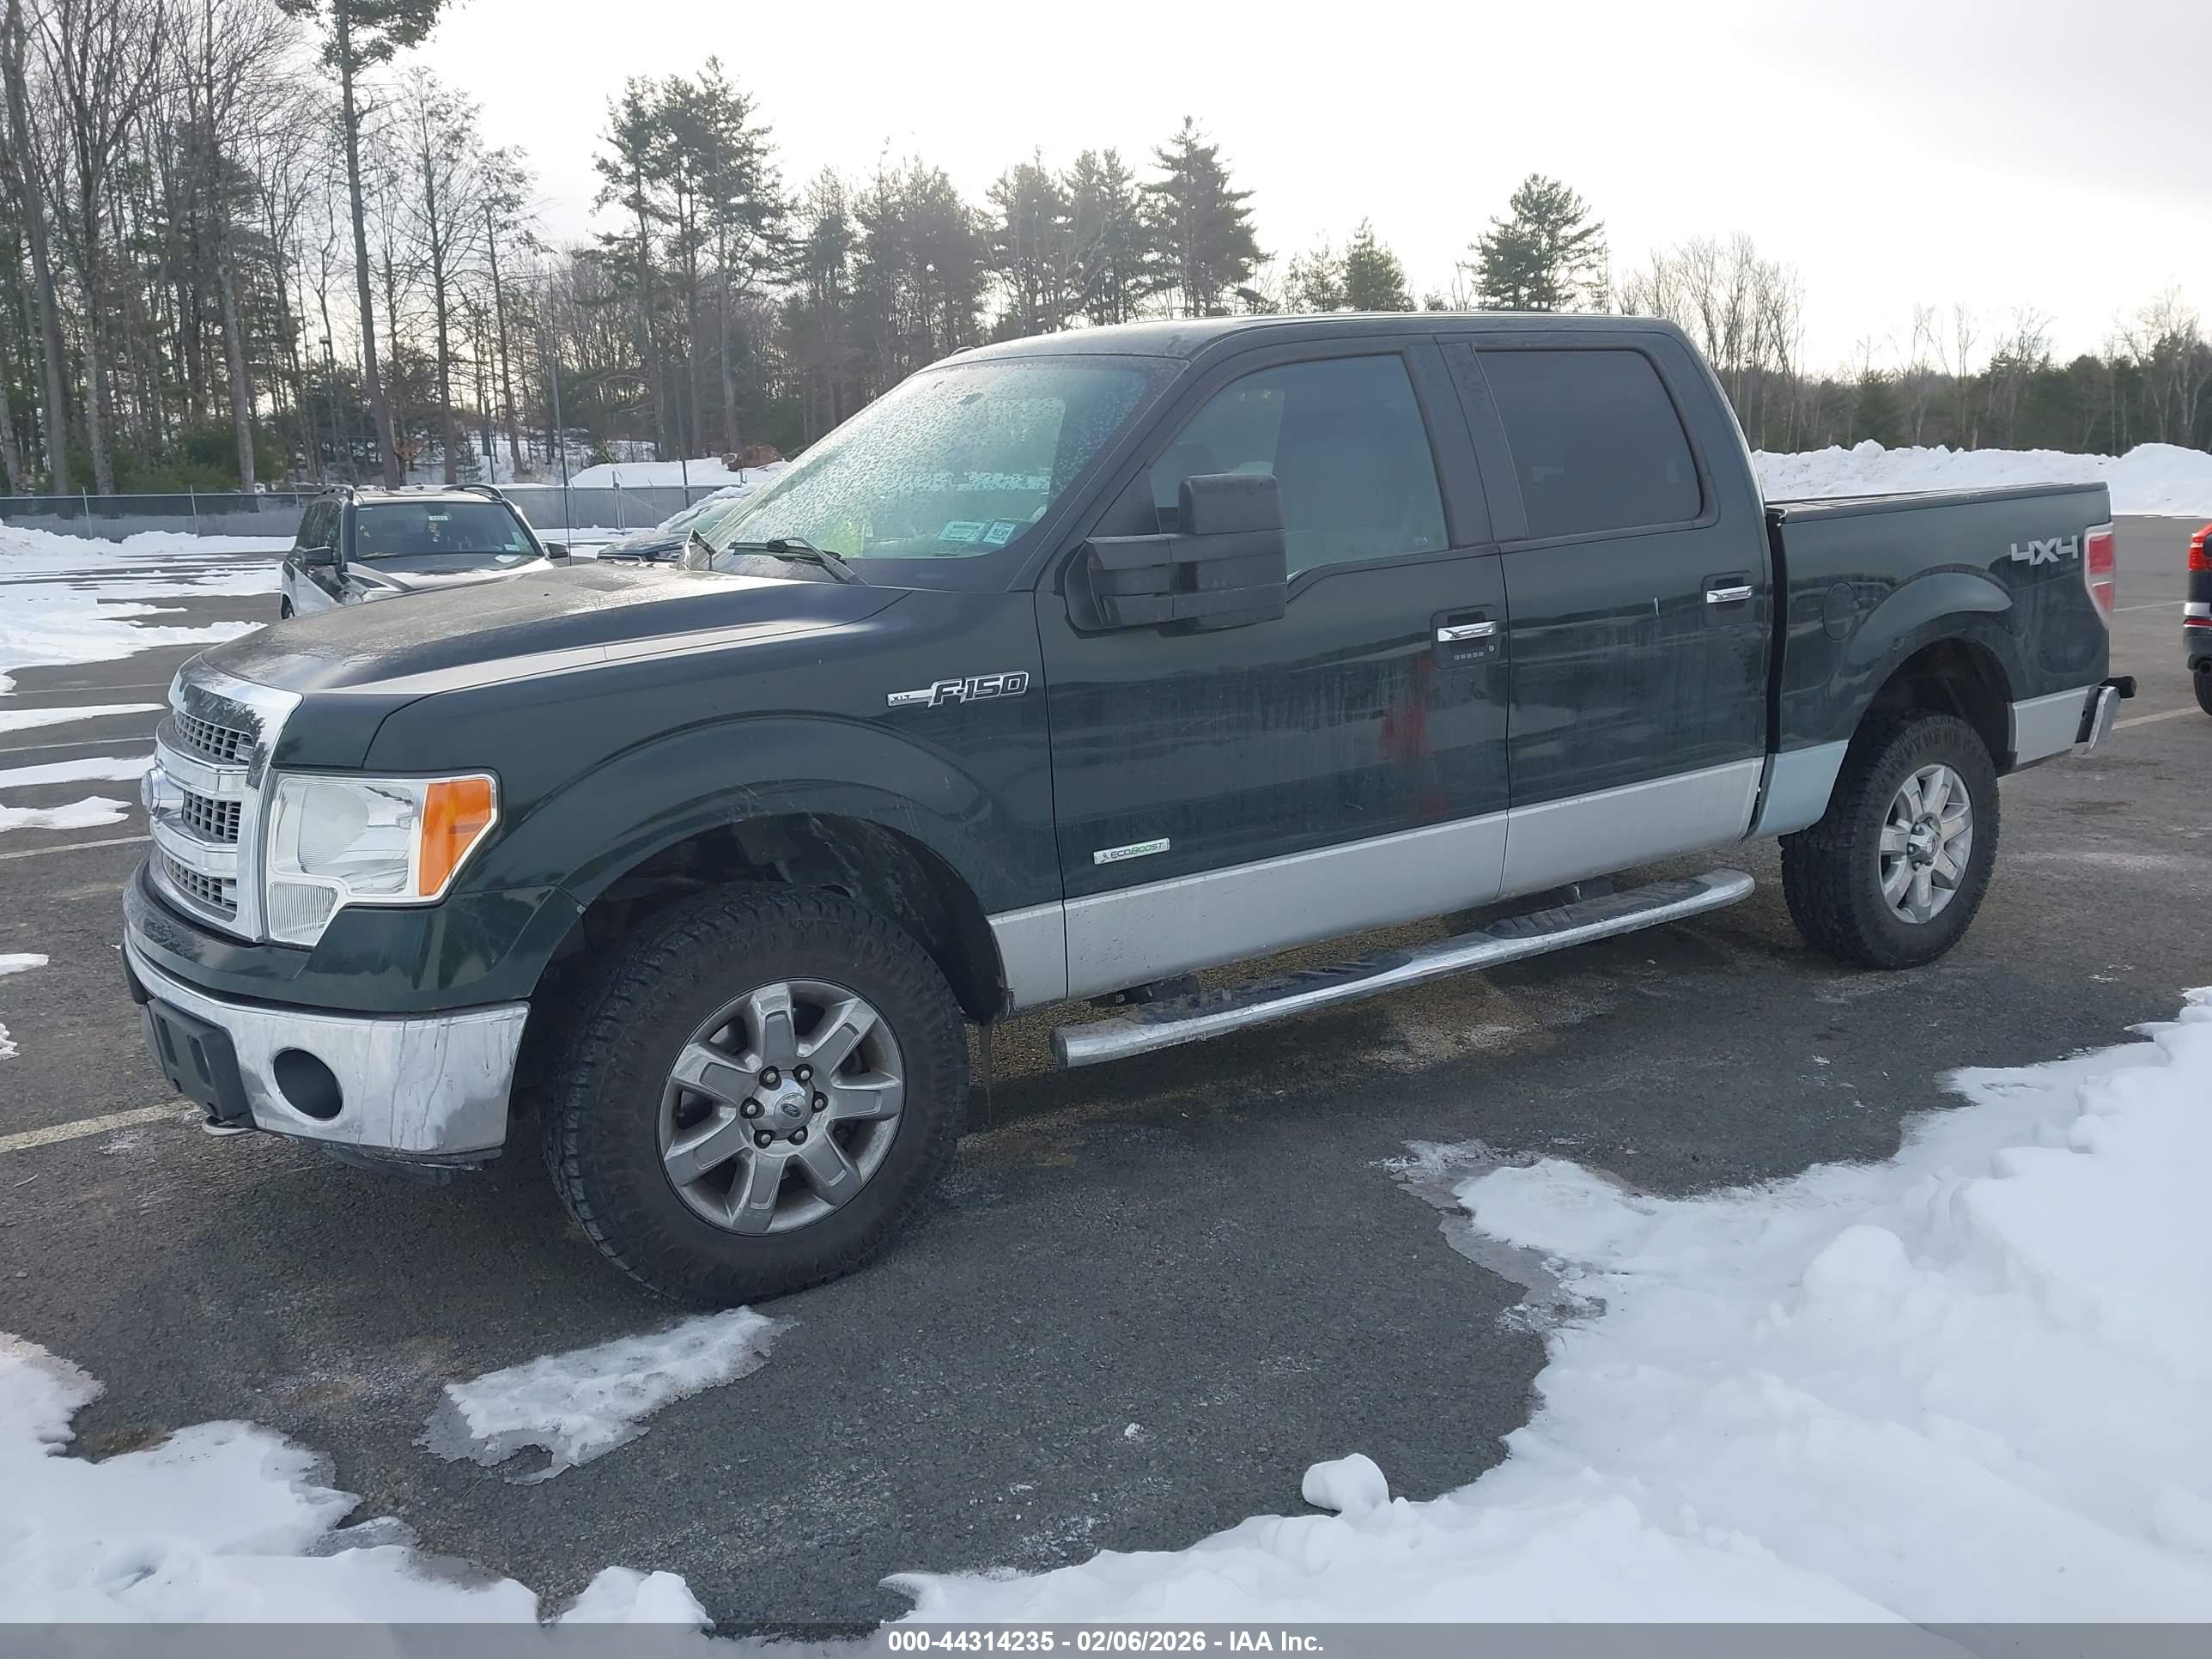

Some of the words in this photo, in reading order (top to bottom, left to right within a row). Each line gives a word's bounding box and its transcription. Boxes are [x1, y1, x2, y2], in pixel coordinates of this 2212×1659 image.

[2010, 535, 2078, 566] 4X4
[892, 694, 912, 702] XLT
[930, 672, 1028, 707] F-150
[1110, 842, 1164, 859] ECOBOOST
